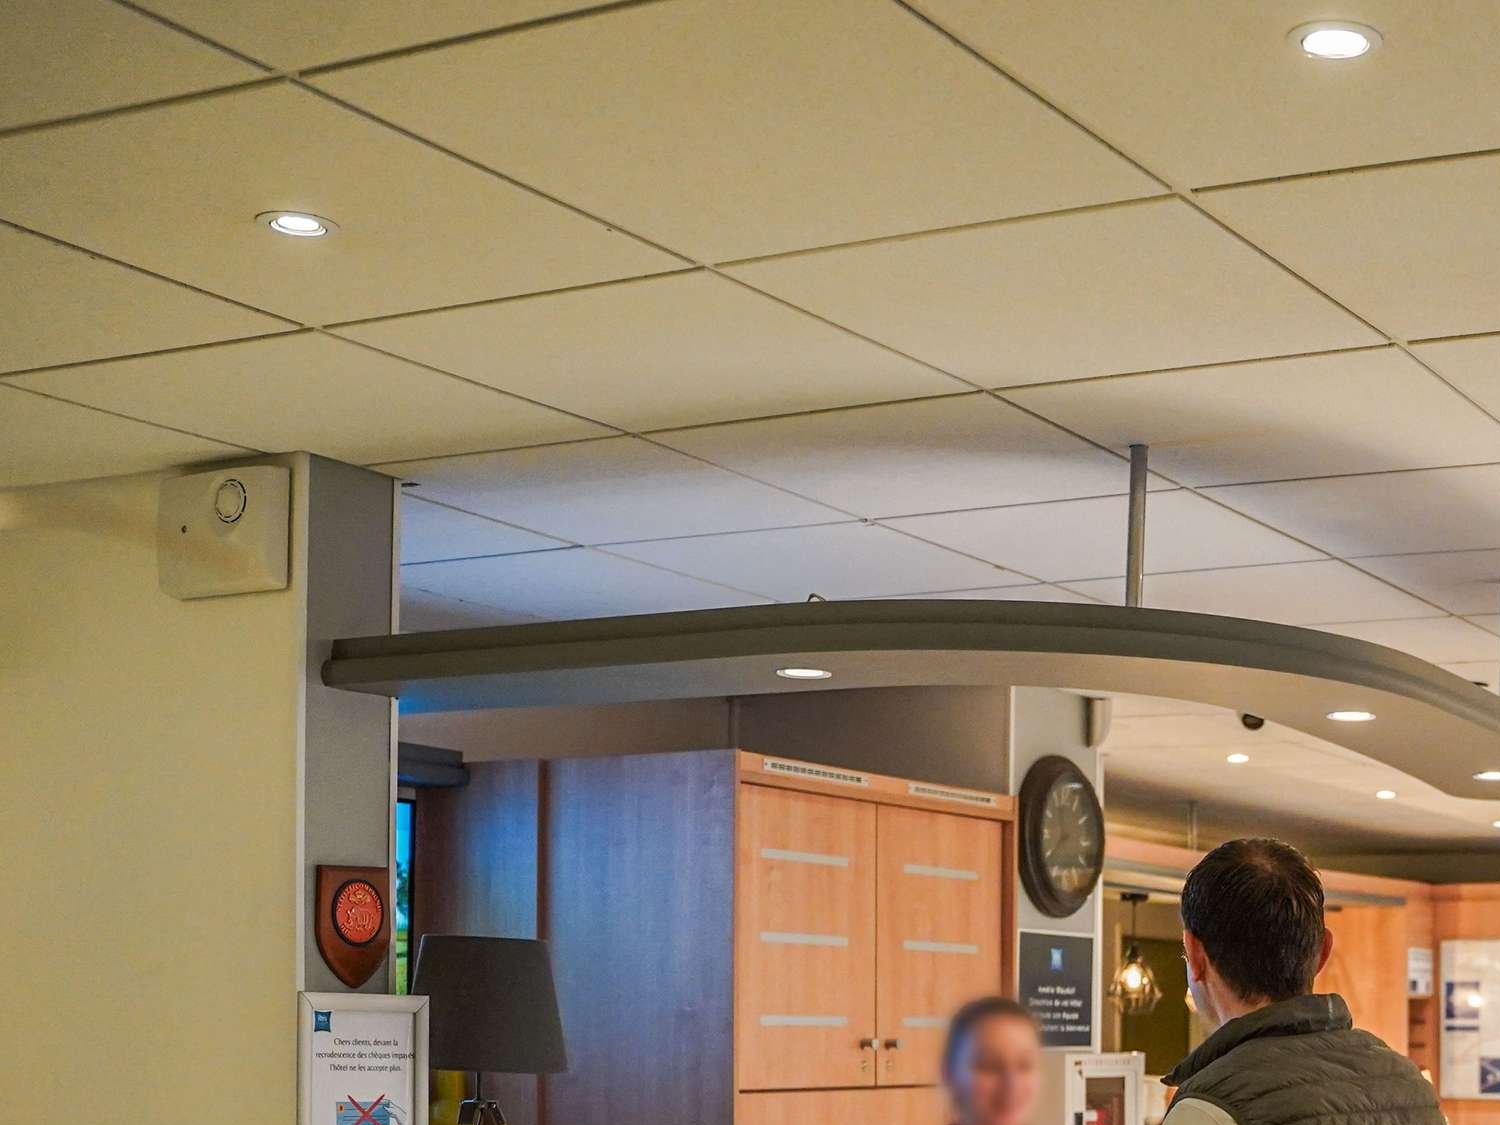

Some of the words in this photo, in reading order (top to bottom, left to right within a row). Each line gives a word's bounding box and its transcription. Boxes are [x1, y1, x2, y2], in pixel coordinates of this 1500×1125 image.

[333, 1037, 351, 1046] Chers
[351, 1038, 372, 1047] clients,
[373, 1038, 392, 1046] devant
[393, 1038, 398, 1046] la
[357, 1051, 367, 1059] des
[367, 1064, 387, 1072] accepte
